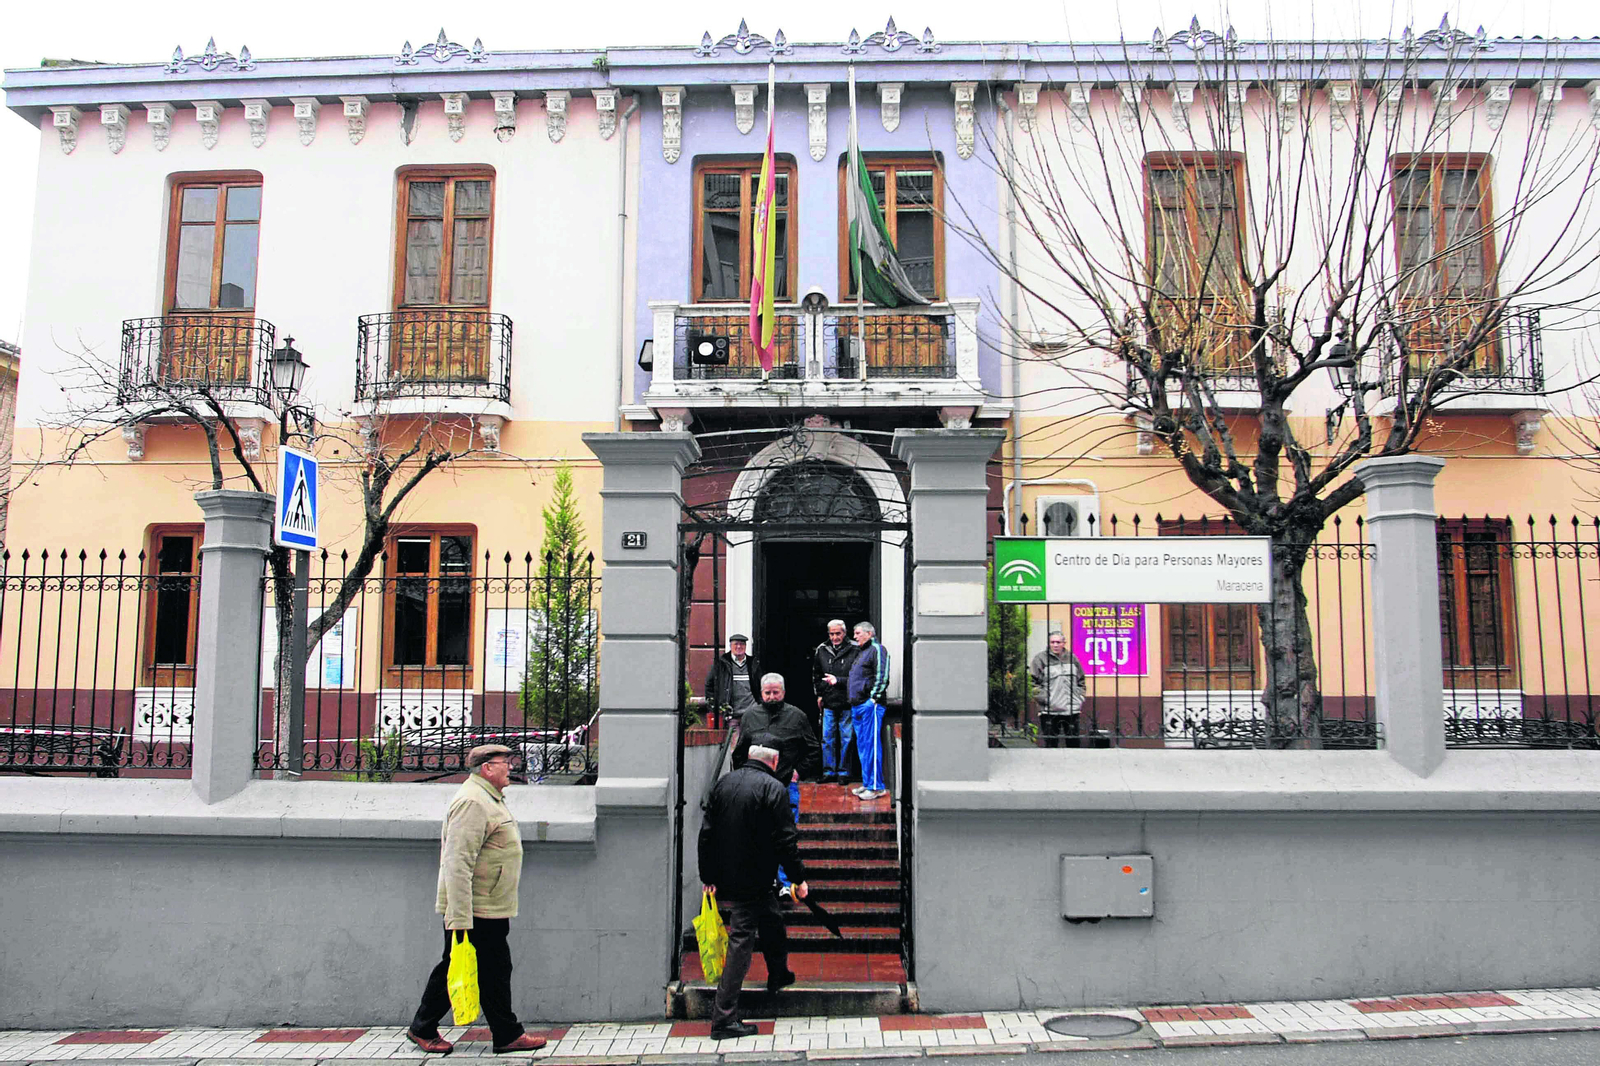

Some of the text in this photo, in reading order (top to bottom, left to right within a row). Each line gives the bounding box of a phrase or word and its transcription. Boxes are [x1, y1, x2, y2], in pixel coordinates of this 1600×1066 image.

[627, 534, 641, 546] 21
[1054, 553, 1263, 568] Centro de Día para Personas Mayores
[1217, 579, 1264, 592] Maracena
[1074, 607, 1142, 617] CONTRA LAS
